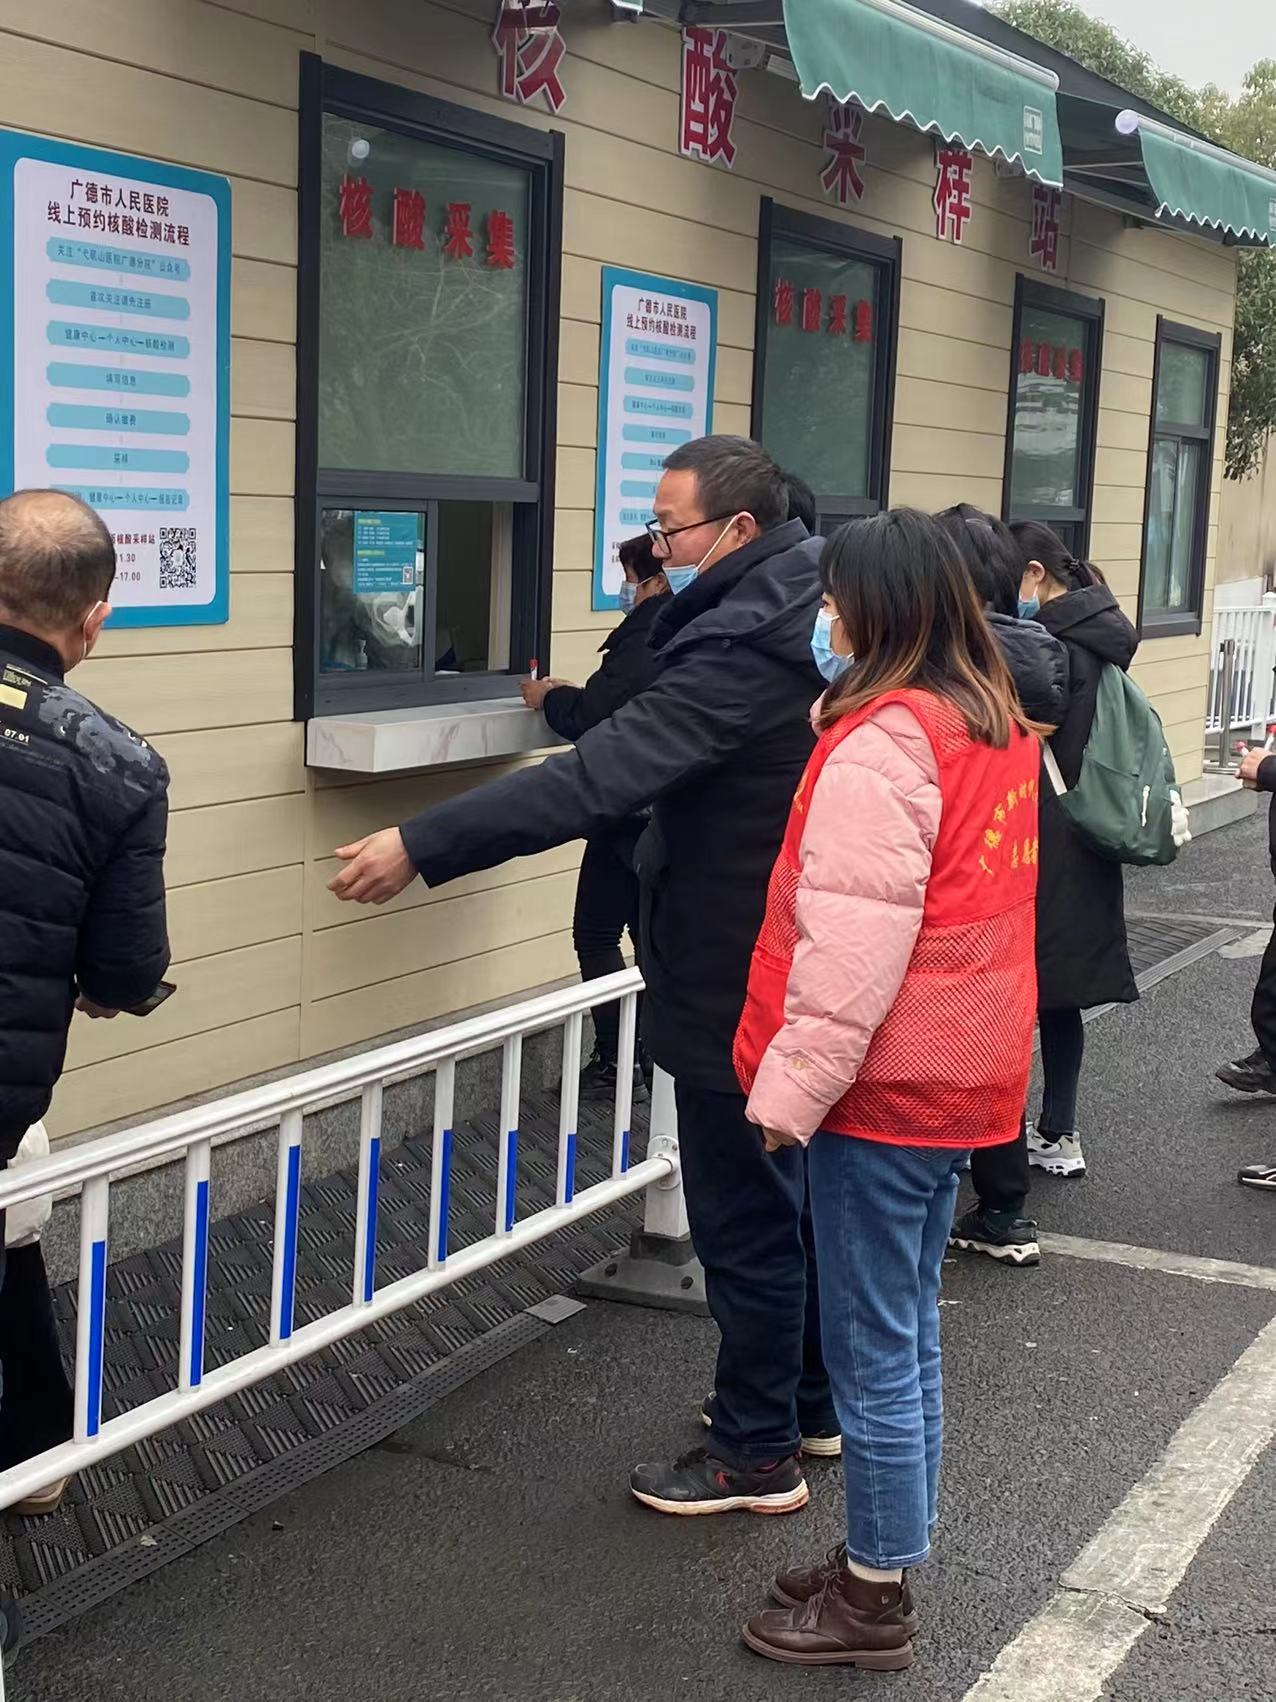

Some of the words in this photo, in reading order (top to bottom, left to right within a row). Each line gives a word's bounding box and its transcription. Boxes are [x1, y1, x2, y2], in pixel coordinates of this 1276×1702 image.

[70, 179, 169, 217] 广德市人民医院
[47, 200, 190, 246] 线上预约核酸检测流程
[338, 173, 516, 269] 核酸采集
[637, 296, 688, 320] 广德市人民医院
[774, 276, 873, 343] 核酸采集
[626, 312, 697, 340] 线上预约核酸检测流程
[106, 373, 137, 387] 填写信息
[113, 452, 129, 464] 采样
